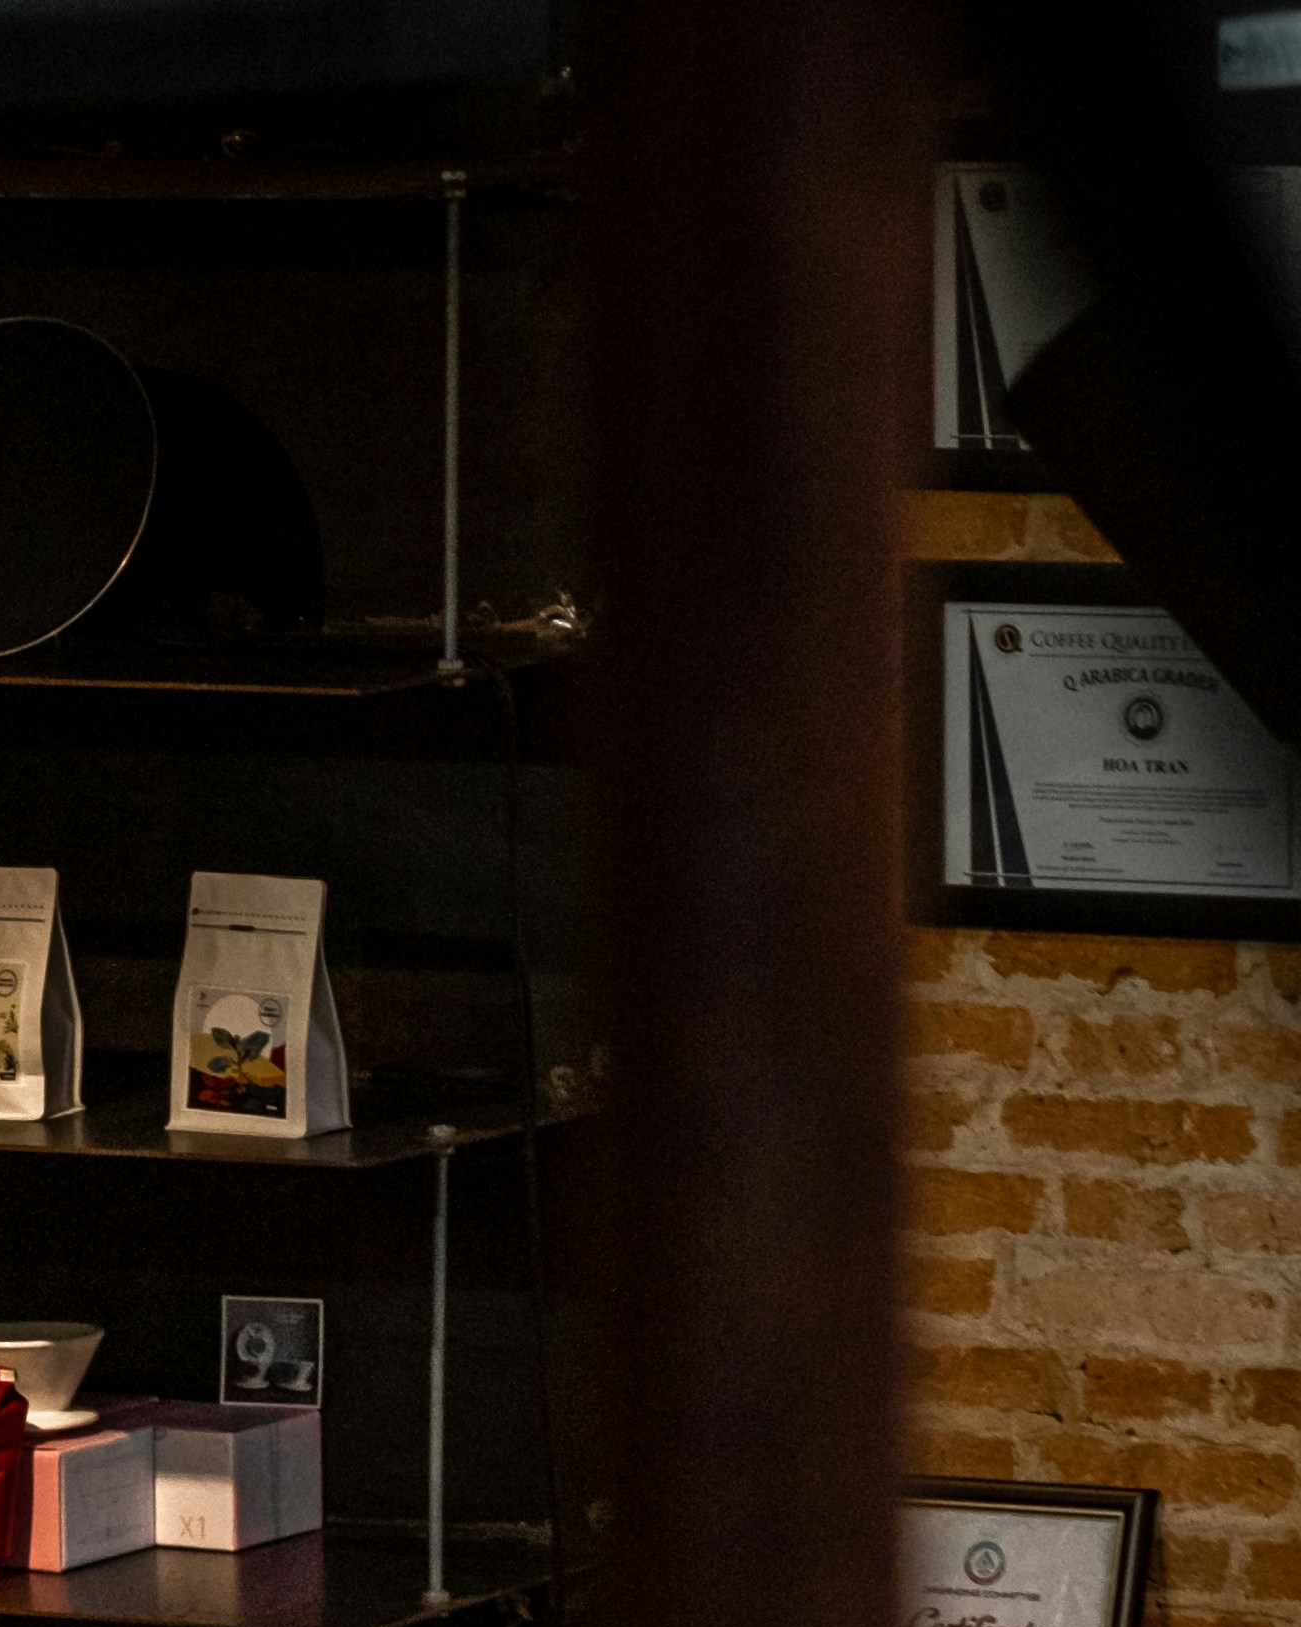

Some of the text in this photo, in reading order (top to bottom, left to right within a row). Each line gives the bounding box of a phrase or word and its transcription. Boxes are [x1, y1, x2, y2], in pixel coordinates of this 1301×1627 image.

[1029, 628, 1096, 650] COFFEE
[1101, 632, 1180, 654] QUALITY
[1062, 667, 1221, 696] Q ARABICA GRADER
[1102, 756, 1191, 775] HOA TRAN
